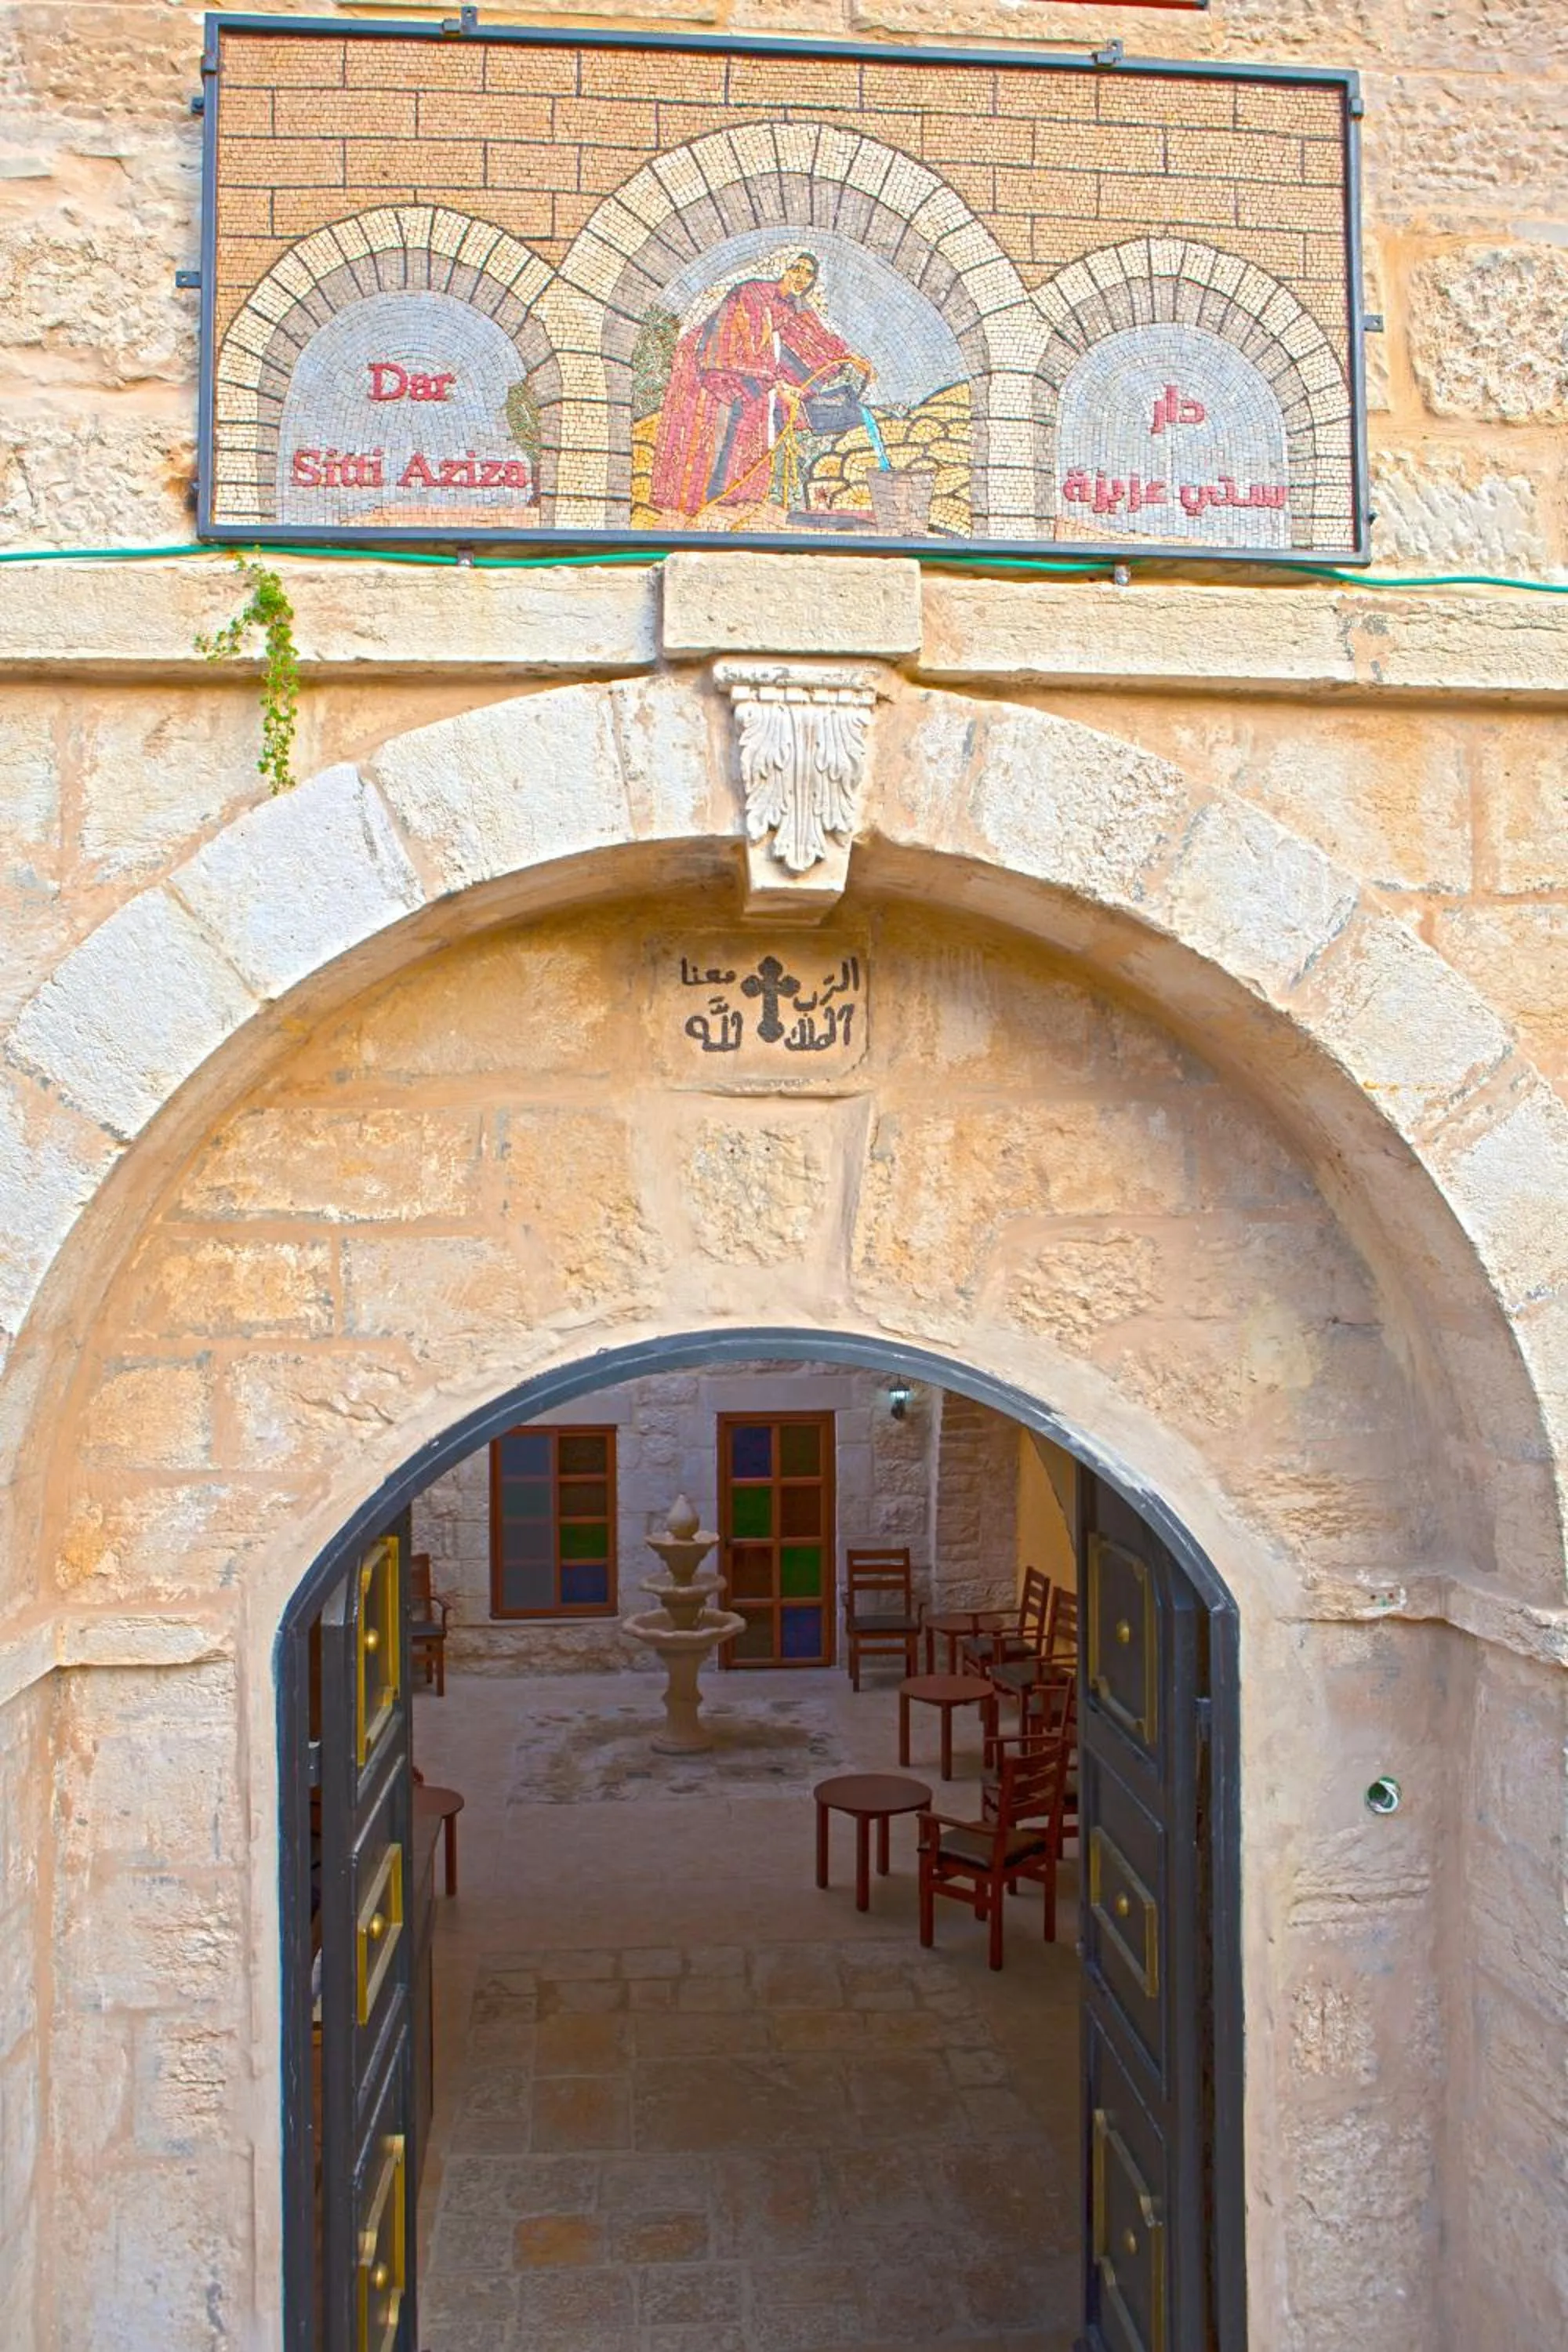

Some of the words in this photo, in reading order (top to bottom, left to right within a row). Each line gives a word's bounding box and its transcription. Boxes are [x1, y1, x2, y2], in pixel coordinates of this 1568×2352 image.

[368, 361, 456, 401] Dar
[1149, 385, 1205, 434] دار
[292, 446, 383, 487] Sitti
[397, 451, 531, 488] Aziza
[1062, 469, 1167, 514] عزيزة
[1178, 475, 1287, 517] ستي
[681, 956, 736, 985] معنا
[784, 1003, 855, 1051] الملك
